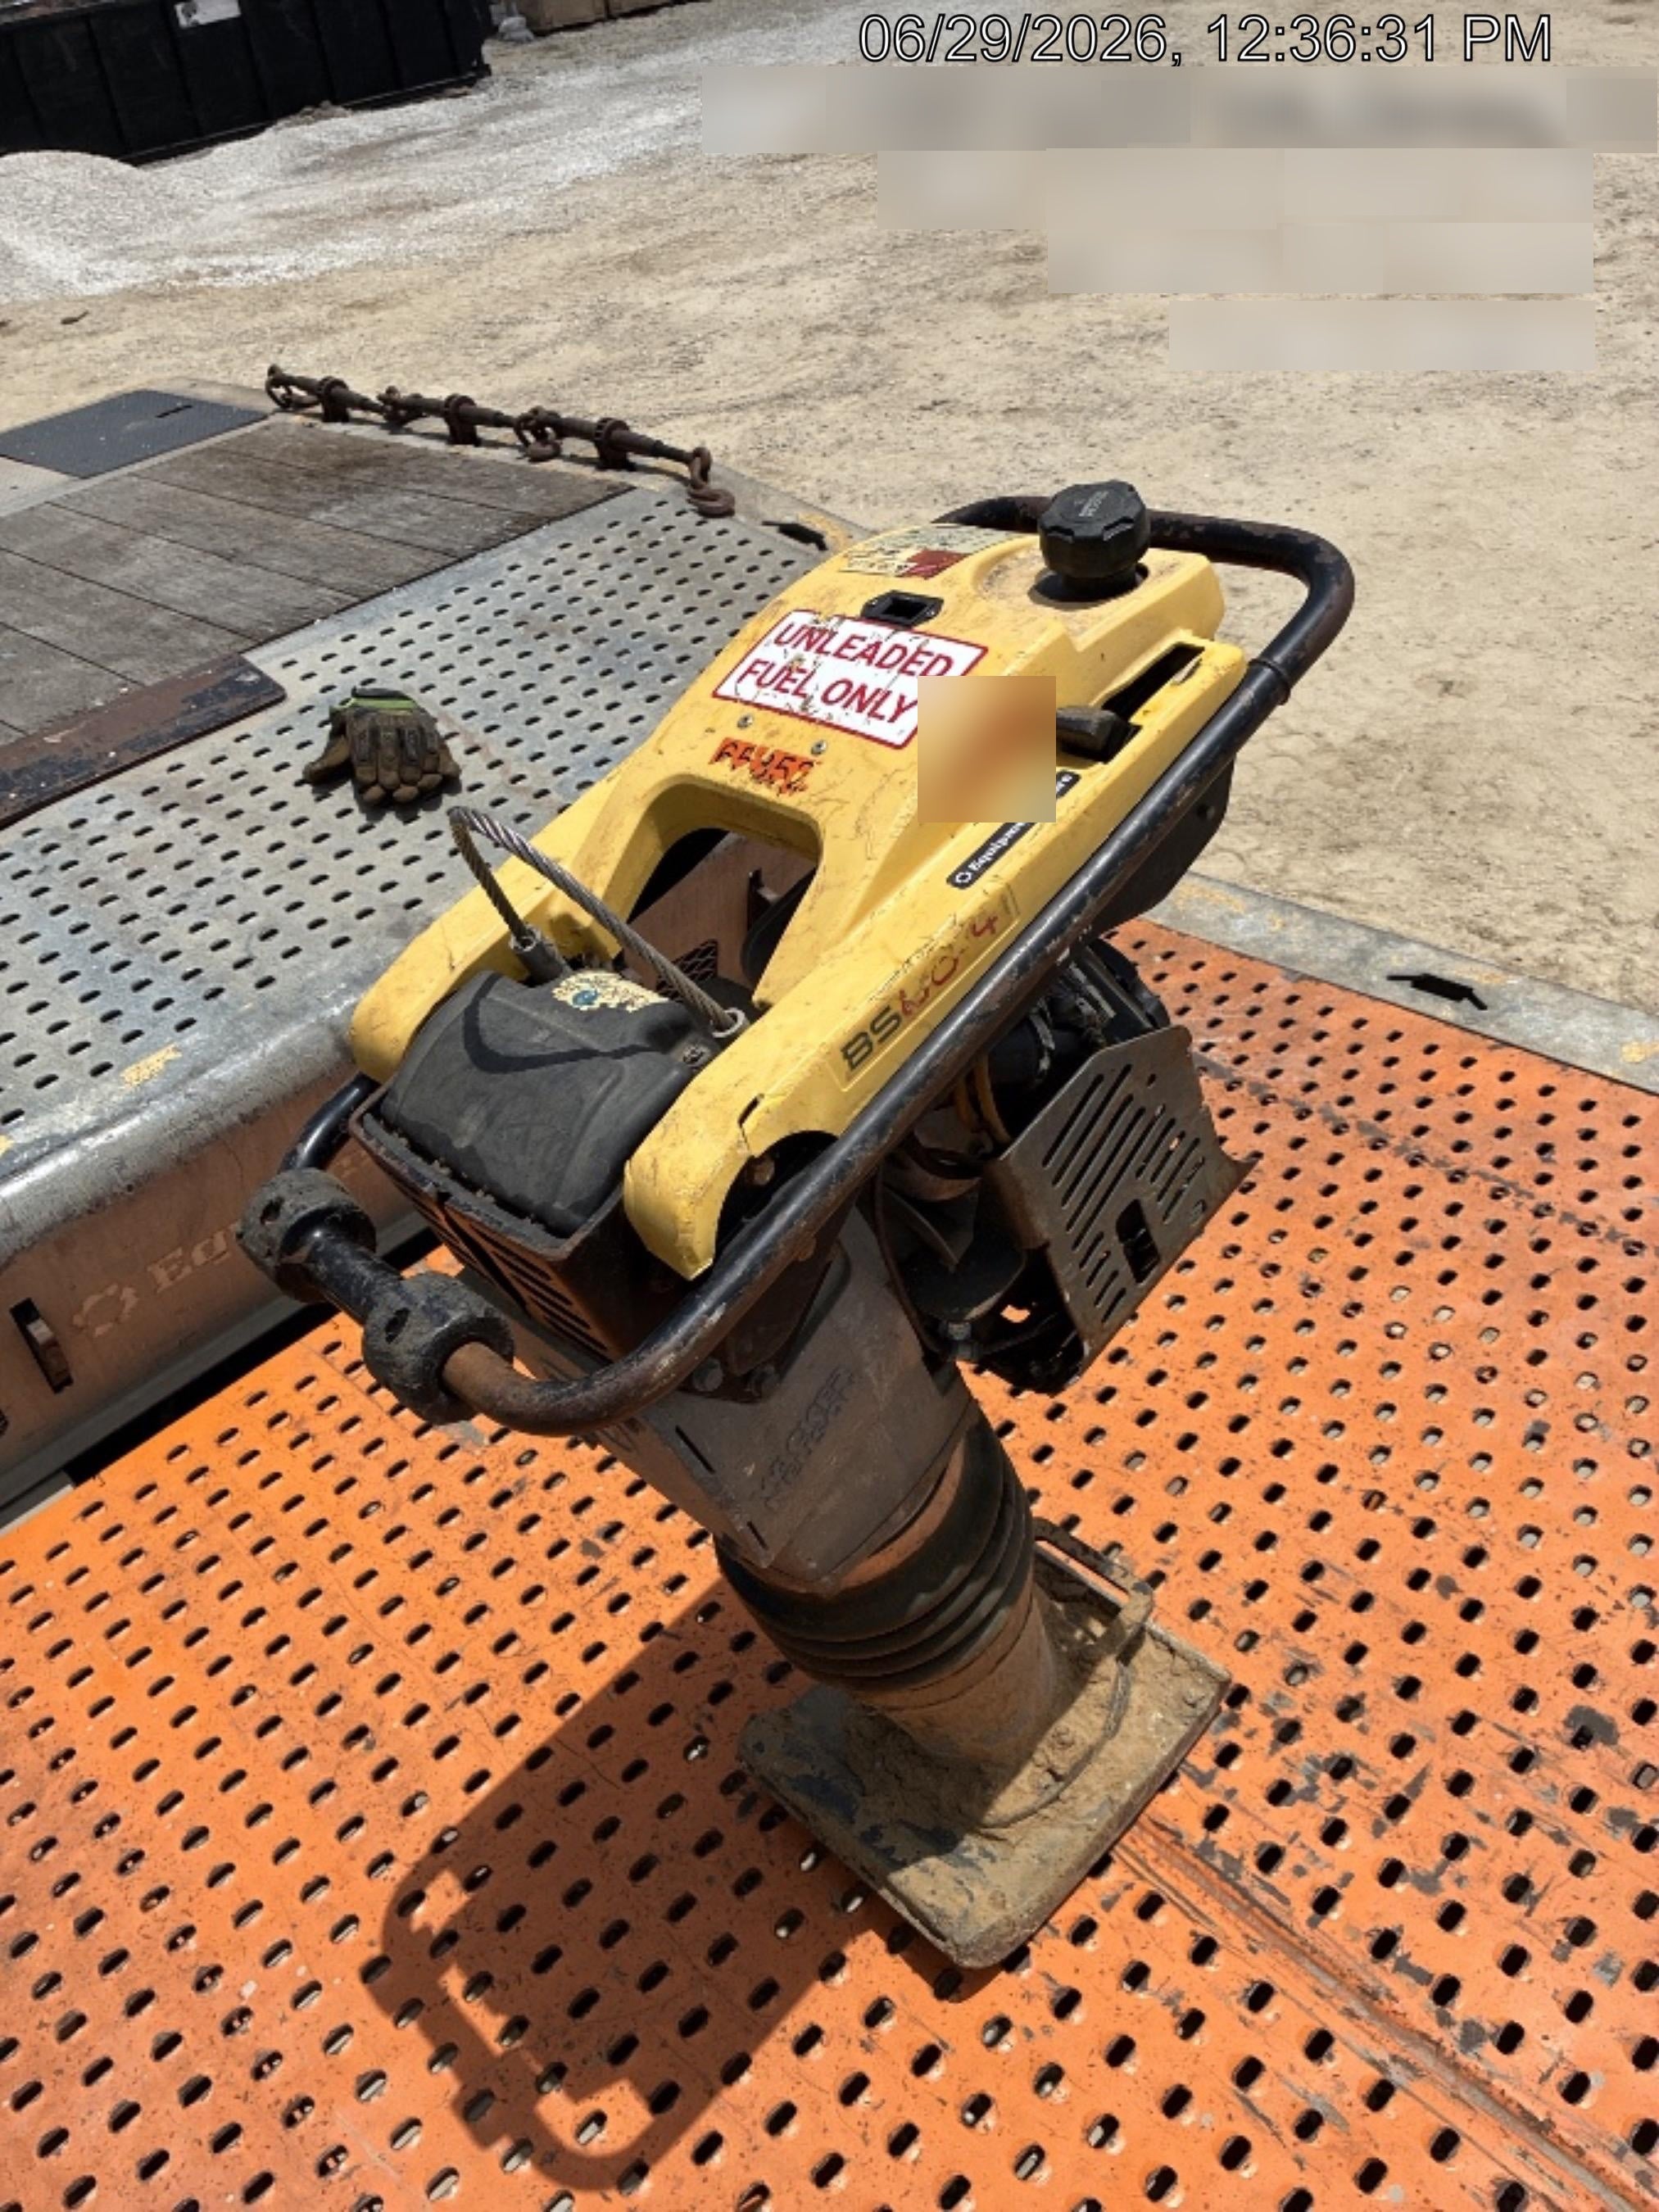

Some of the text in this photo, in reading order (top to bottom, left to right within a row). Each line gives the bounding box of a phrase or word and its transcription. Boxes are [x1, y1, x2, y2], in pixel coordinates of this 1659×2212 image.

[774, 622, 954, 676] UNLEADED
[737, 658, 918, 723] FUEL ONLY
